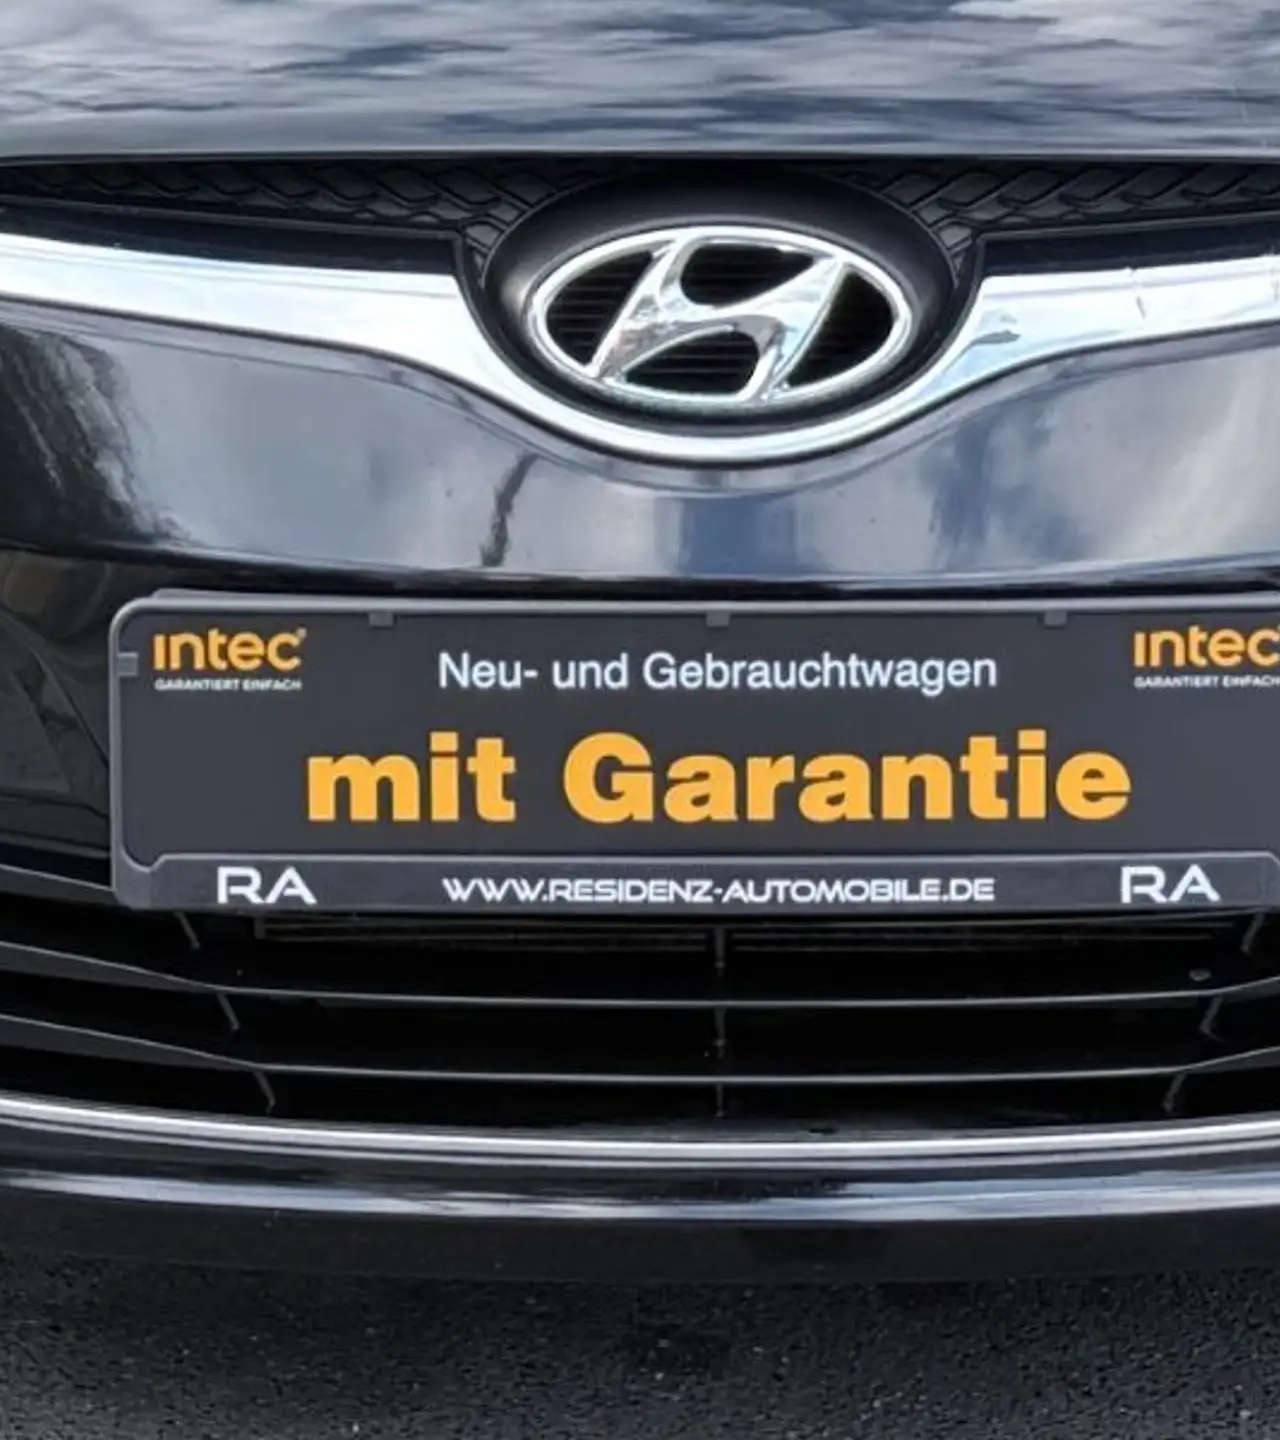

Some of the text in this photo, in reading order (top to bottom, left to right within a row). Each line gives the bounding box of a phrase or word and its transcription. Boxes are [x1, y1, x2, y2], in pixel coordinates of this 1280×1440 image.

[154, 627, 302, 671] intec
[154, 677, 303, 692] GARANTIERT EINFACH
[439, 651, 997, 697] Neu- und Gebrauchtwagen
[1134, 674, 1219, 690] GARANTIERT
[308, 729, 1131, 823] mit Garantie
[218, 866, 316, 905] RA
[442, 877, 995, 904] WWW.RESIDENZ-AUTOMOBILE.DE
[1121, 864, 1220, 904] RA
